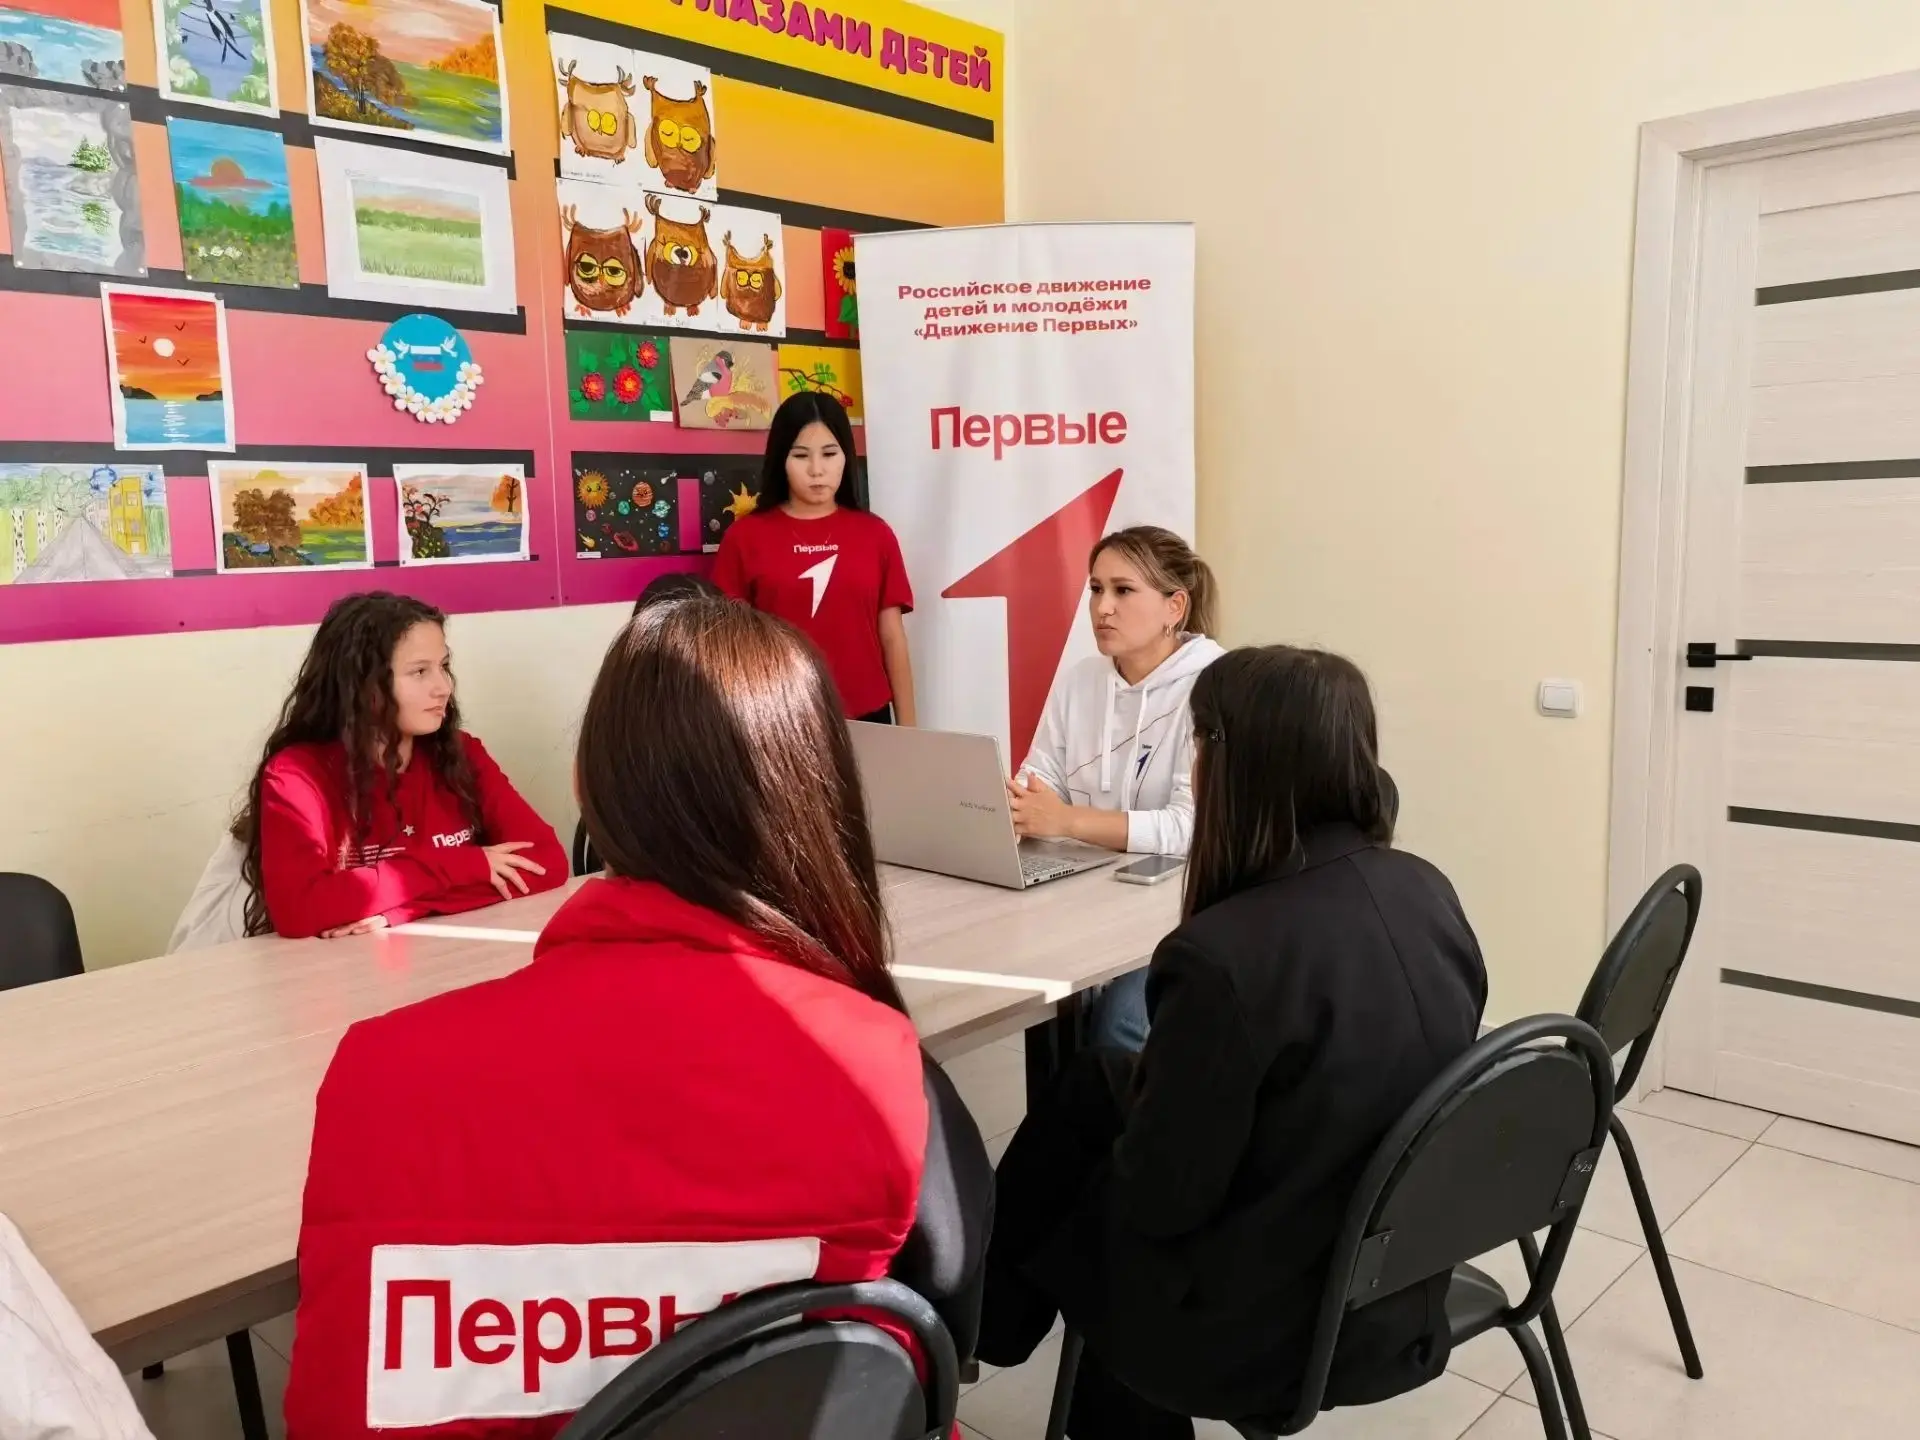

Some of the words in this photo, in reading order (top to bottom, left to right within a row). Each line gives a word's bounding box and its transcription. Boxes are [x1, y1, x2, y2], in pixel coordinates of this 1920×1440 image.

[670, 0, 872, 58] АЗАМИ
[880, 27, 991, 92] ДЕТЕЙ
[898, 279, 1032, 299] Российское
[1036, 278, 1151, 296] движение
[924, 300, 988, 320] детей
[993, 302, 1006, 314] и
[1011, 297, 1127, 314] молодёжи
[914, 321, 1038, 339] «Движение
[1042, 317, 1138, 334] Первых»
[930, 406, 1128, 461] Первые
[793, 544, 839, 555] Первые
[432, 828, 475, 848] Перв
[384, 1279, 739, 1394] Перв
